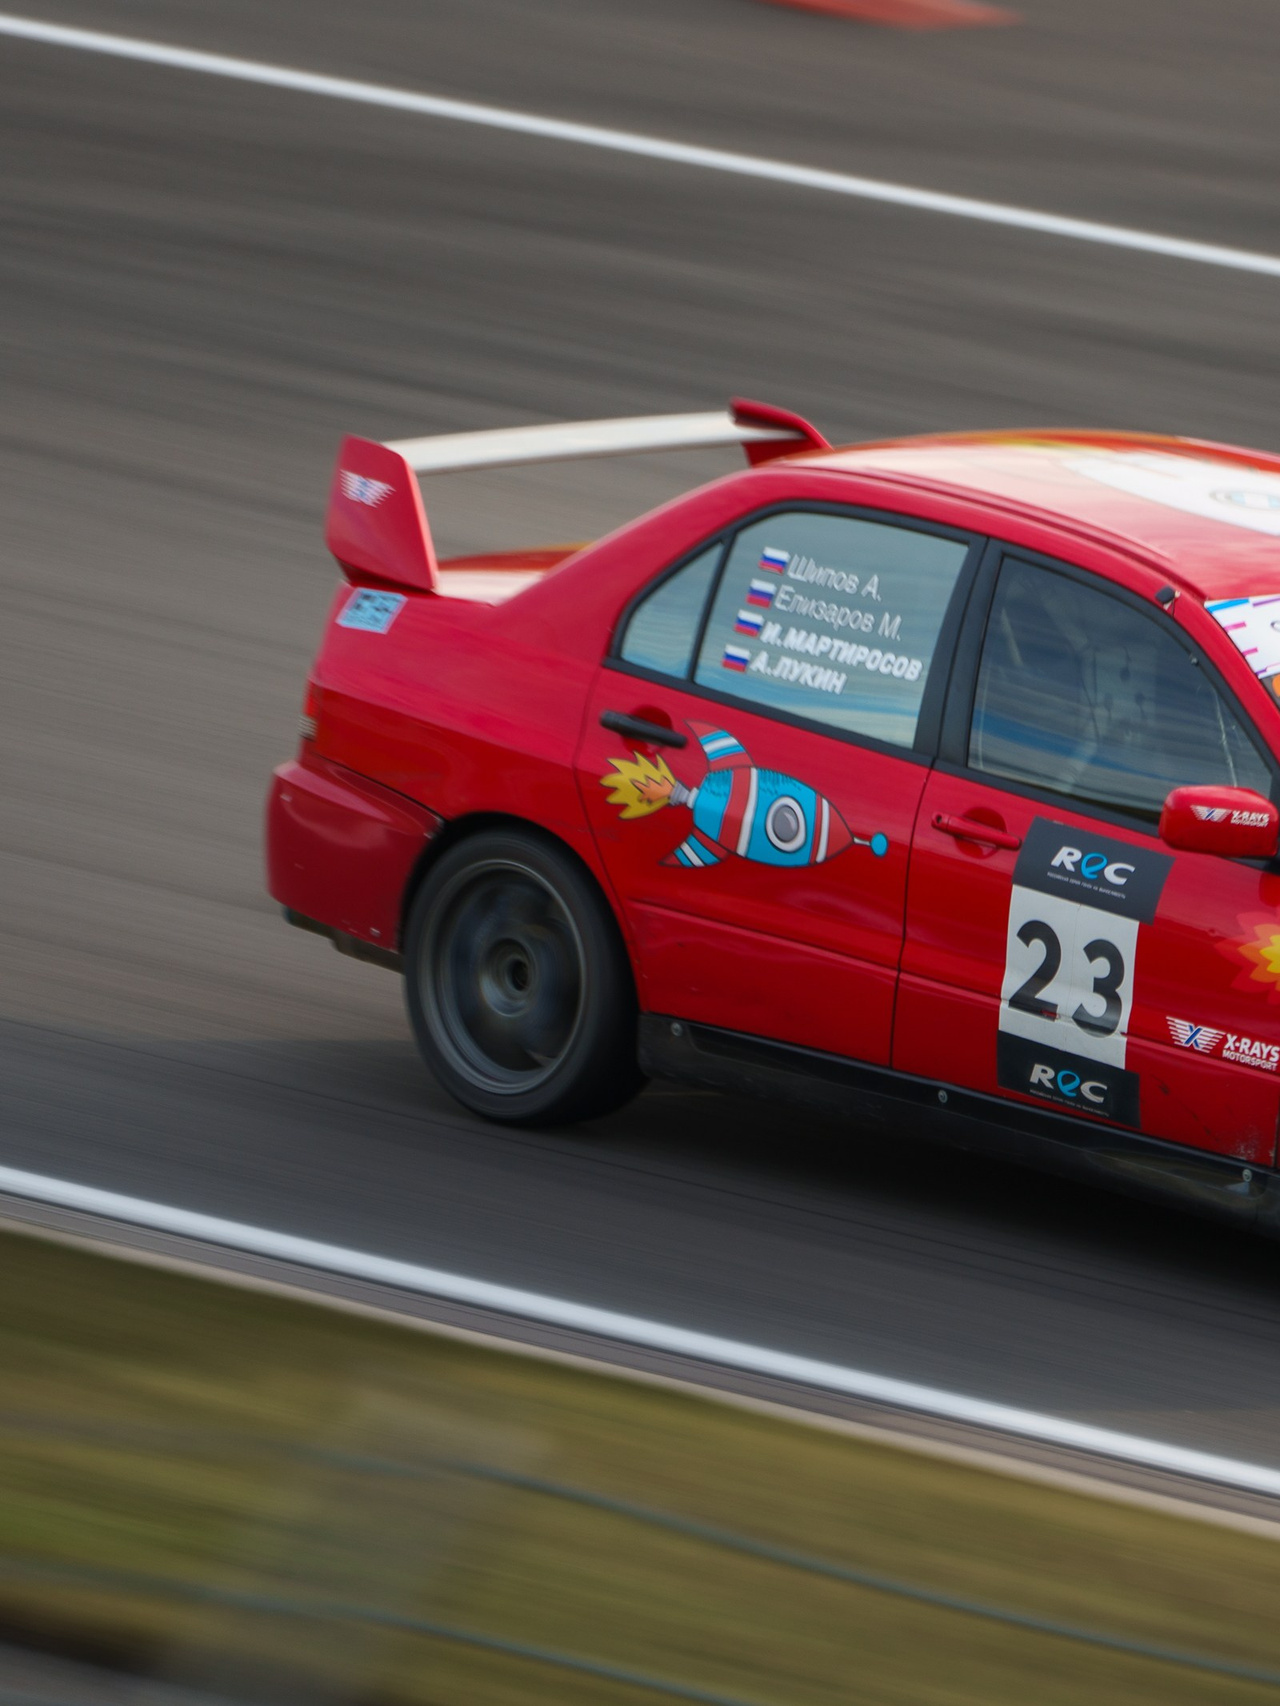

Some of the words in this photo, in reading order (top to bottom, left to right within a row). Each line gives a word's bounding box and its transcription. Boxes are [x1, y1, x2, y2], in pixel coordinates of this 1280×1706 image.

[787, 554, 859, 594] Шипов
[774, 584, 875, 632] Елизаров
[1231, 810, 1270, 824] X-RAYS
[1008, 919, 1125, 1038] 23
[1222, 1049, 1278, 1071] MOTORSPORT
[1224, 1033, 1280, 1062] X-RAYS
